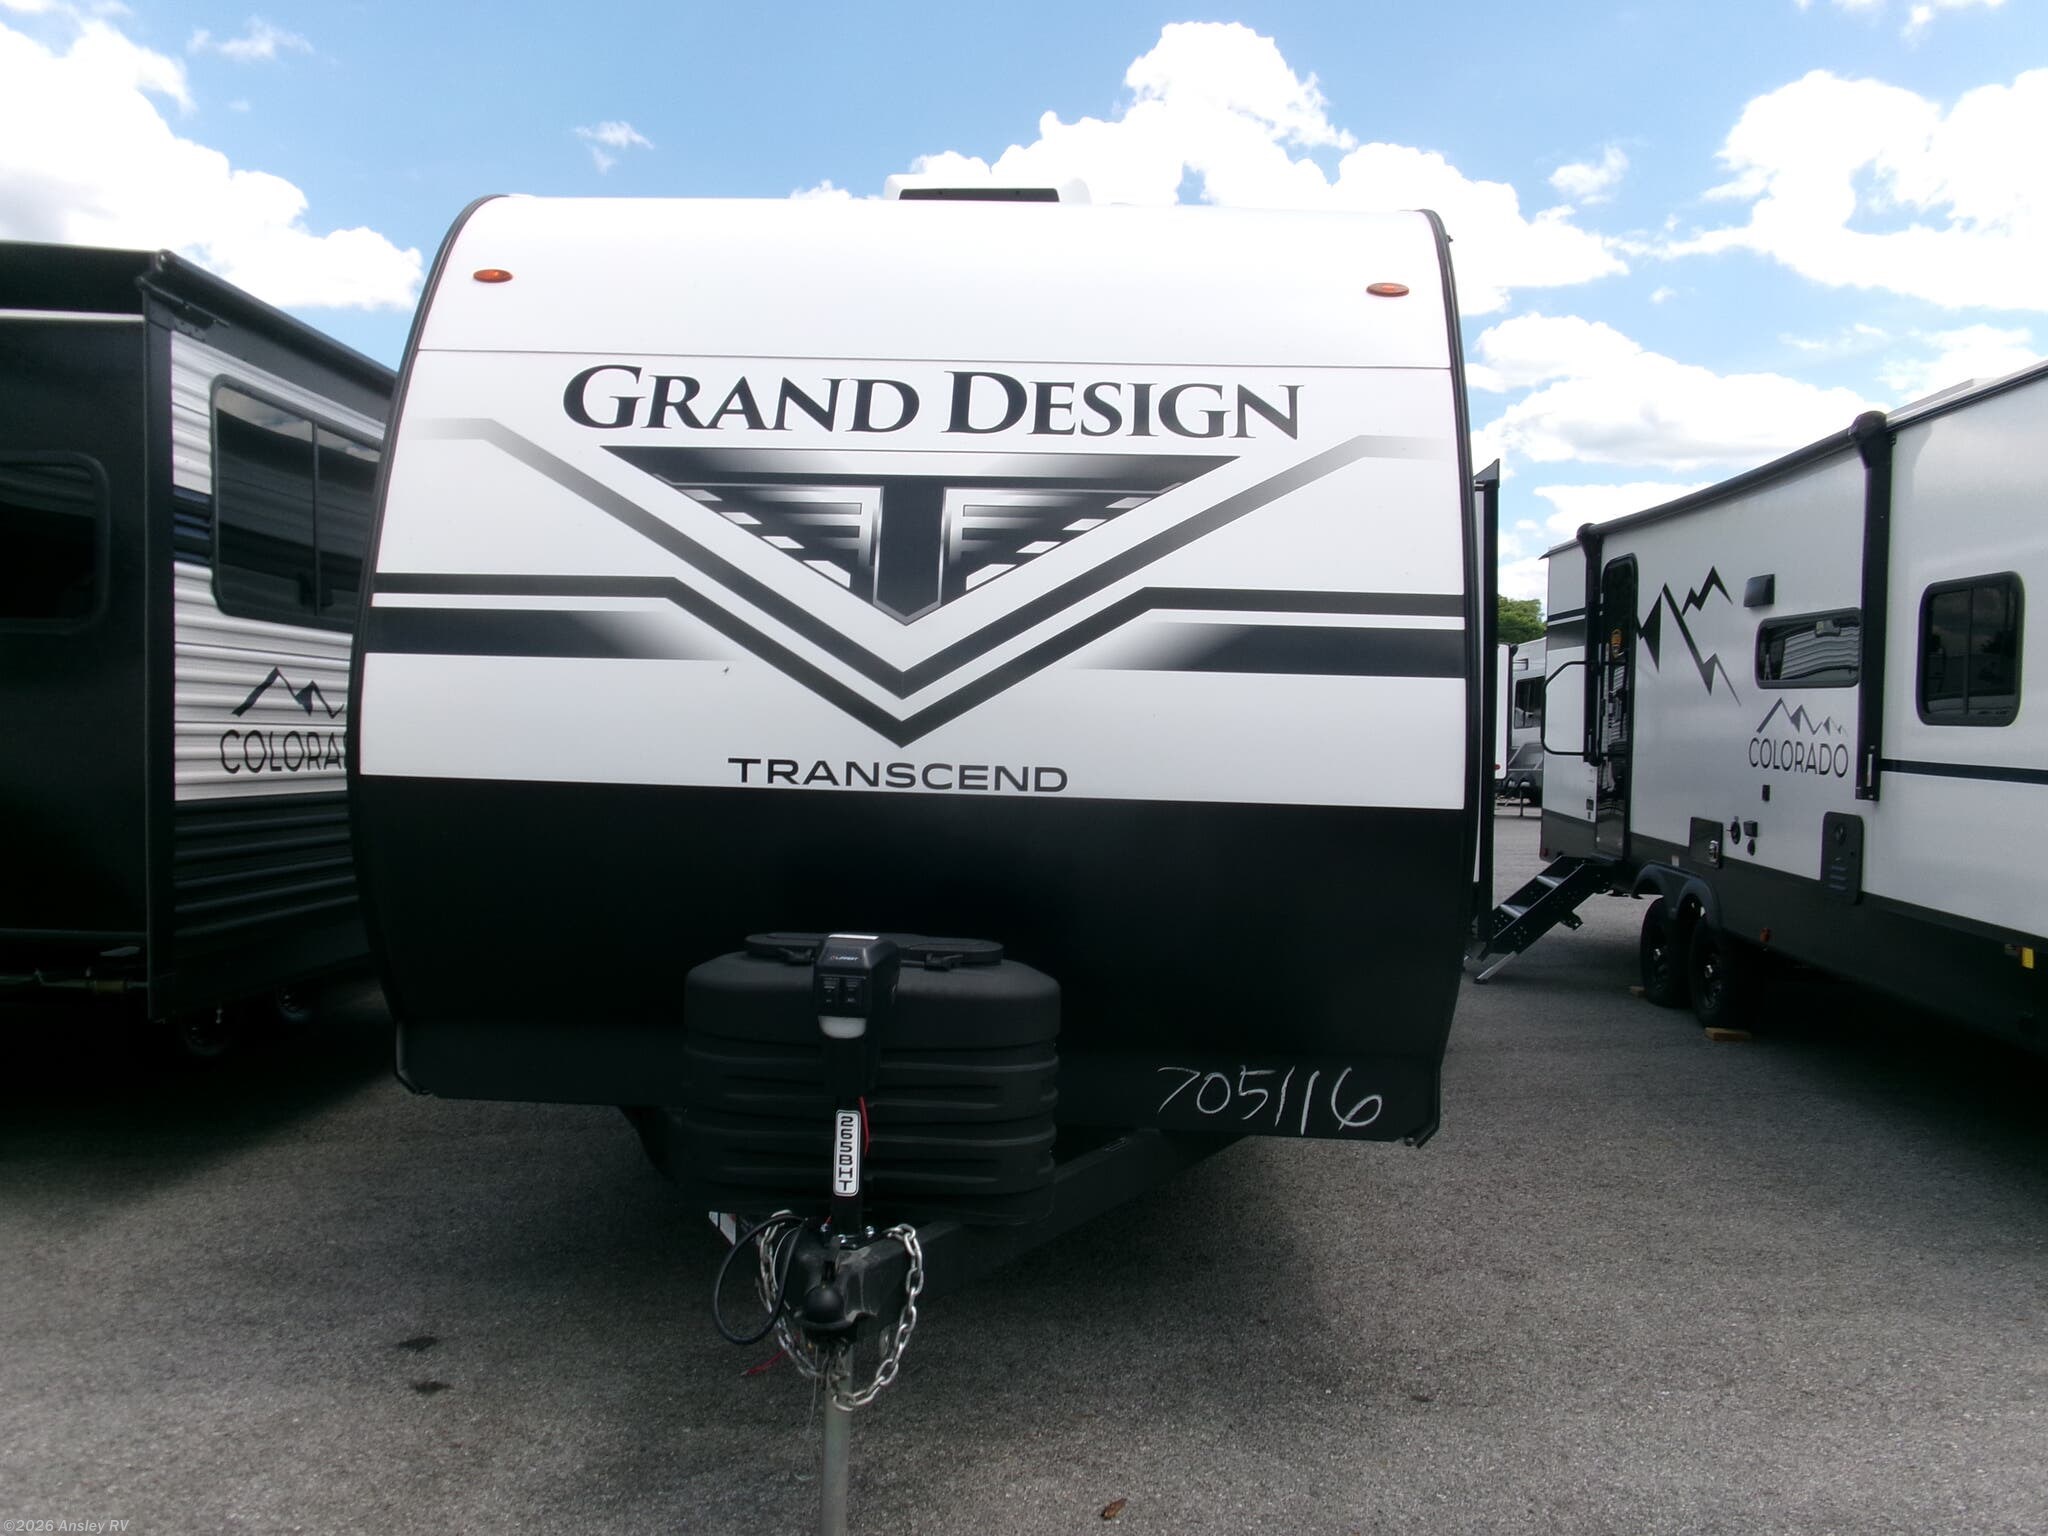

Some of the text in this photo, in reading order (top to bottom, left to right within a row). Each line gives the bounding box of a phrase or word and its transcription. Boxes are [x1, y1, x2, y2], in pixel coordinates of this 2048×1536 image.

[562, 364, 1305, 440] GRAND DESIGN
[220, 728, 347, 774] COLORA
[1748, 736, 1849, 779] COLORADO
[727, 756, 1069, 793] TRANSCEND
[837, 1115, 854, 1192] 265BHT
